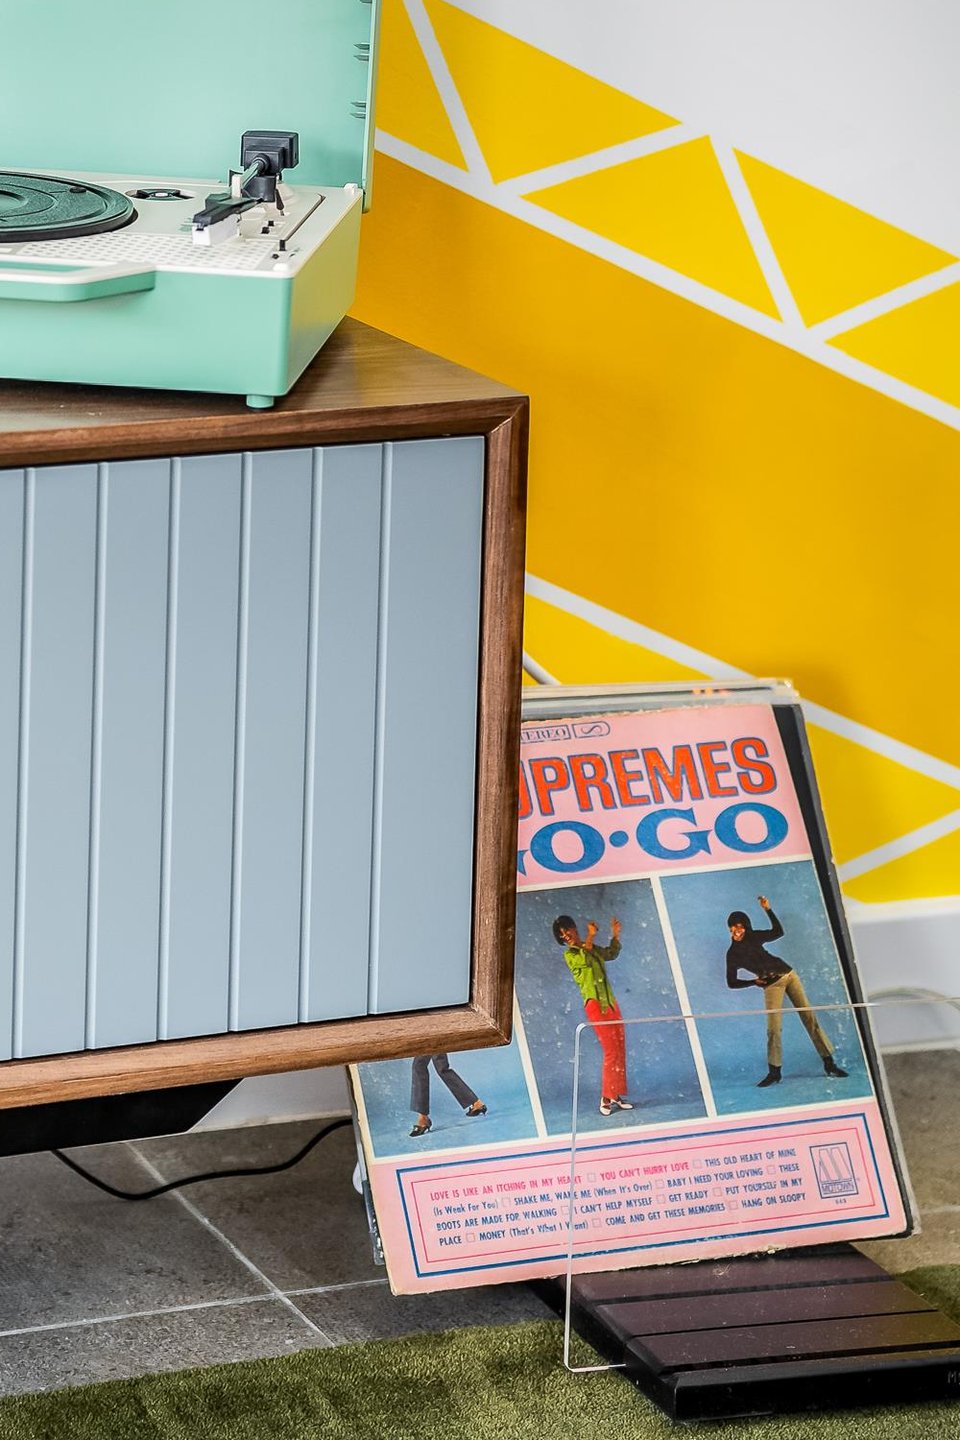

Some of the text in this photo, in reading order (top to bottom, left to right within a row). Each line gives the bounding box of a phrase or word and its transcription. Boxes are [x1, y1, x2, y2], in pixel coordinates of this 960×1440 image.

[520, 727, 567, 741] EREO
[519, 737, 778, 819] PREMES
[430, 1190, 449, 1201] LOVE
[452, 1189, 460, 1198] IS
[463, 1187, 479, 1197] LIKE
[482, 1185, 494, 1194] AN
[496, 1181, 526, 1193] ITCHING
[529, 1180, 539, 1189] IN
[541, 1177, 553, 1187] MY
[600, 1170, 617, 1181] YOU
[619, 1168, 641, 1179] CAN'T
[643, 1165, 668, 1176] HURRY
[671, 1161, 689, 1172] LOVE
[704, 1157, 721, 1167] THIS
[723, 1155, 738, 1165] OLD
[740, 1152, 763, 1163] HEART
[765, 1150, 775, 1159] OF
[777, 1148, 797, 1158] MINE
[433, 1205, 443, 1216] (Is
[445, 1202, 466, 1215] Weak
[468, 1203, 479, 1212] For
[514, 1194, 539, 1206] SHAKE
[540, 1193, 553, 1203] ME,
[580, 1189, 592, 1198] ME
[593, 1186, 617, 1198] (When
[619, 1184, 631, 1194] It's
[633, 1181, 653, 1192] Over)
[667, 1177, 686, 1188] BABY
[693, 1174, 712, 1184] NEED
[713, 1170, 735, 1181] YOUR
[736, 1167, 764, 1179] LOVING
[778, 1163, 800, 1173] THESE
[436, 1219, 461, 1231] BOOTS
[464, 1217, 478, 1228] ARE
[481, 1214, 504, 1226] MADE
[506, 1212, 520, 1222] FOR
[522, 1208, 558, 1220] WALKING
[580, 1203, 602, 1214] CAN'T
[605, 1200, 622, 1211] HELP
[626, 1197, 654, 1208] MYSELF
[668, 1193, 682, 1203] GET
[685, 1190, 709, 1200] READY
[725, 1186, 740, 1195] PUT
[743, 1181, 777, 1193] YOURSELF
[780, 1179, 789, 1188] IN
[791, 1178, 802, 1187] MY
[439, 1235, 463, 1247] PLACE
[479, 1229, 506, 1241] MONEY
[509, 1226, 535, 1238] (That's
[538, 1223, 557, 1233] What
[605, 1215, 627, 1226] COME
[629, 1212, 645, 1223] AND
[647, 1210, 662, 1221] GET
[665, 1208, 686, 1218] THESE
[688, 1202, 726, 1215] MEMORIES
[742, 1198, 763, 1208] HANG
[766, 1196, 777, 1205] ON
[779, 1192, 806, 1204] SLOOPY
